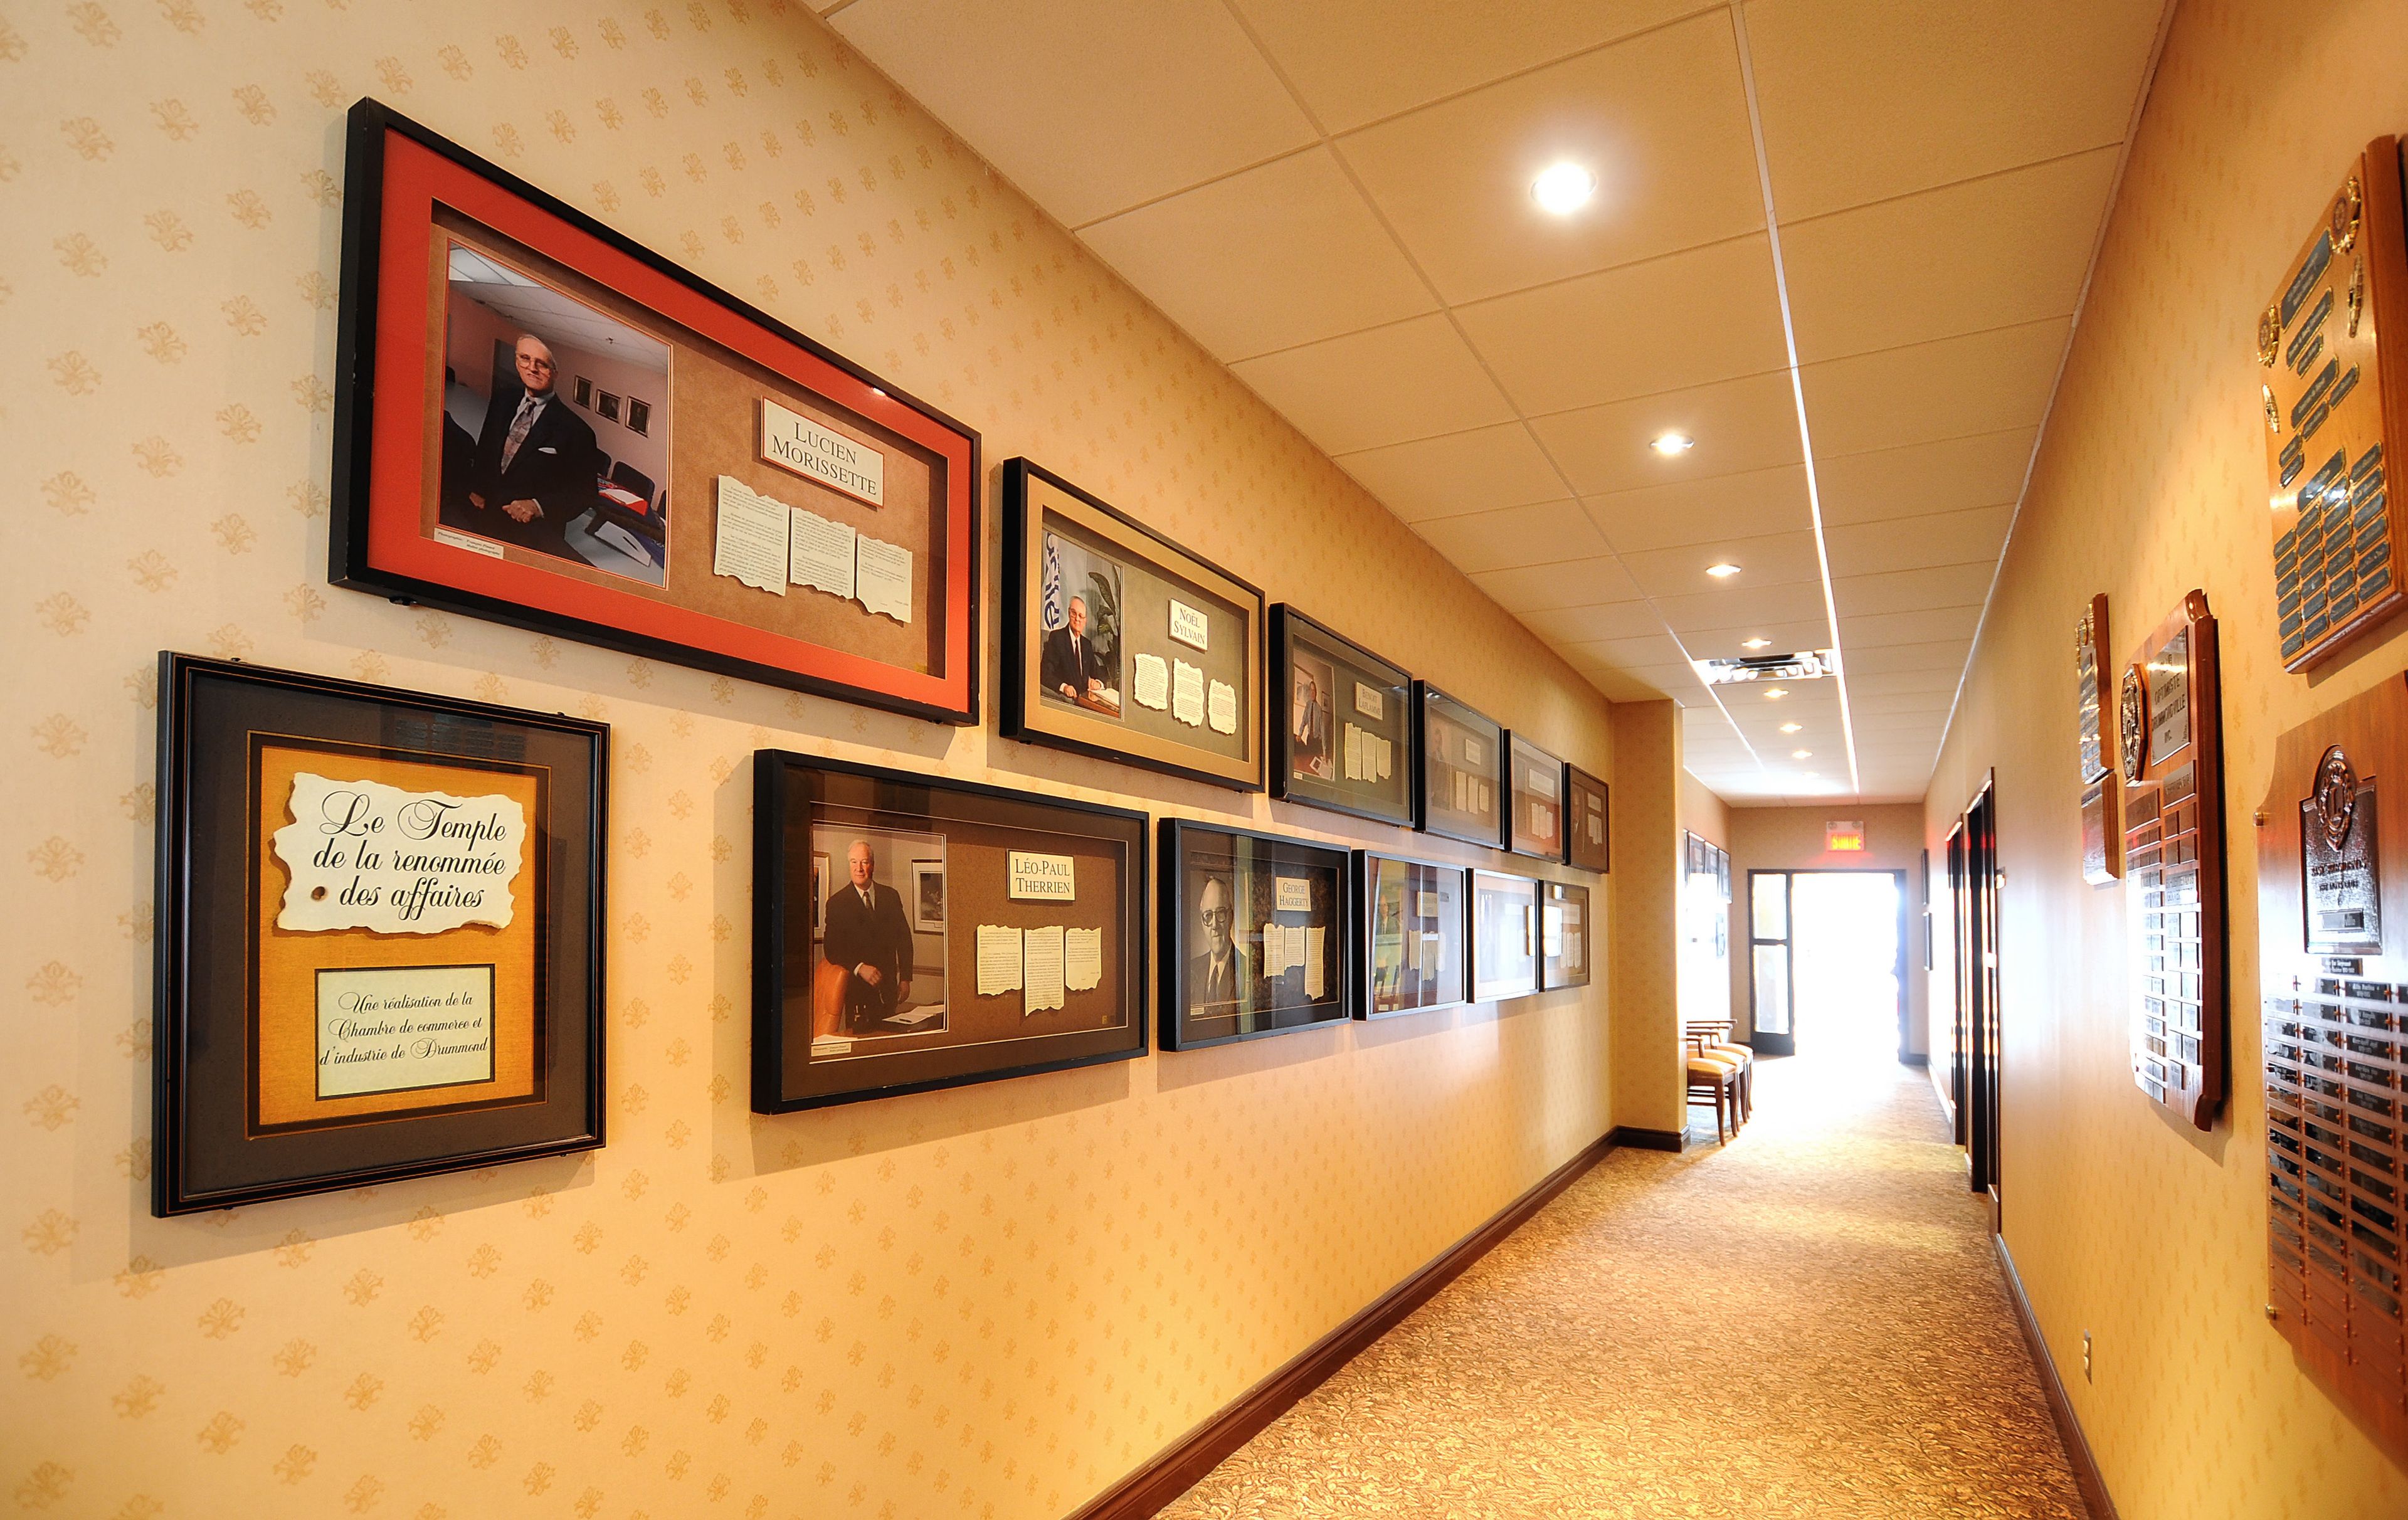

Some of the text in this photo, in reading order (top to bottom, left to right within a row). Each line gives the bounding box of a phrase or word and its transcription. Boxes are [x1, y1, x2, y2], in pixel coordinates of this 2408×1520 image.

[794, 421, 857, 465] LUCIEN
[772, 435, 877, 495] MORISSETTE
[1180, 608, 1200, 628] NOËL
[1174, 620, 1205, 645] SYLVAIN
[319, 791, 507, 852] Le Temple
[314, 838, 506, 875] de la renommée
[1015, 857, 1070, 877] LÉO-PAUL
[339, 875, 485, 921] des affaires
[1015, 877, 1070, 894] THERRIEN
[1282, 882, 1306, 894] GEORGE
[1279, 895, 1309, 907] HAGGERTY
[338, 991, 473, 1015] Une réalisation de la
[327, 1017, 482, 1042] Chambre de commerce et
[319, 1037, 488, 1066] d'industrie de Drummond
